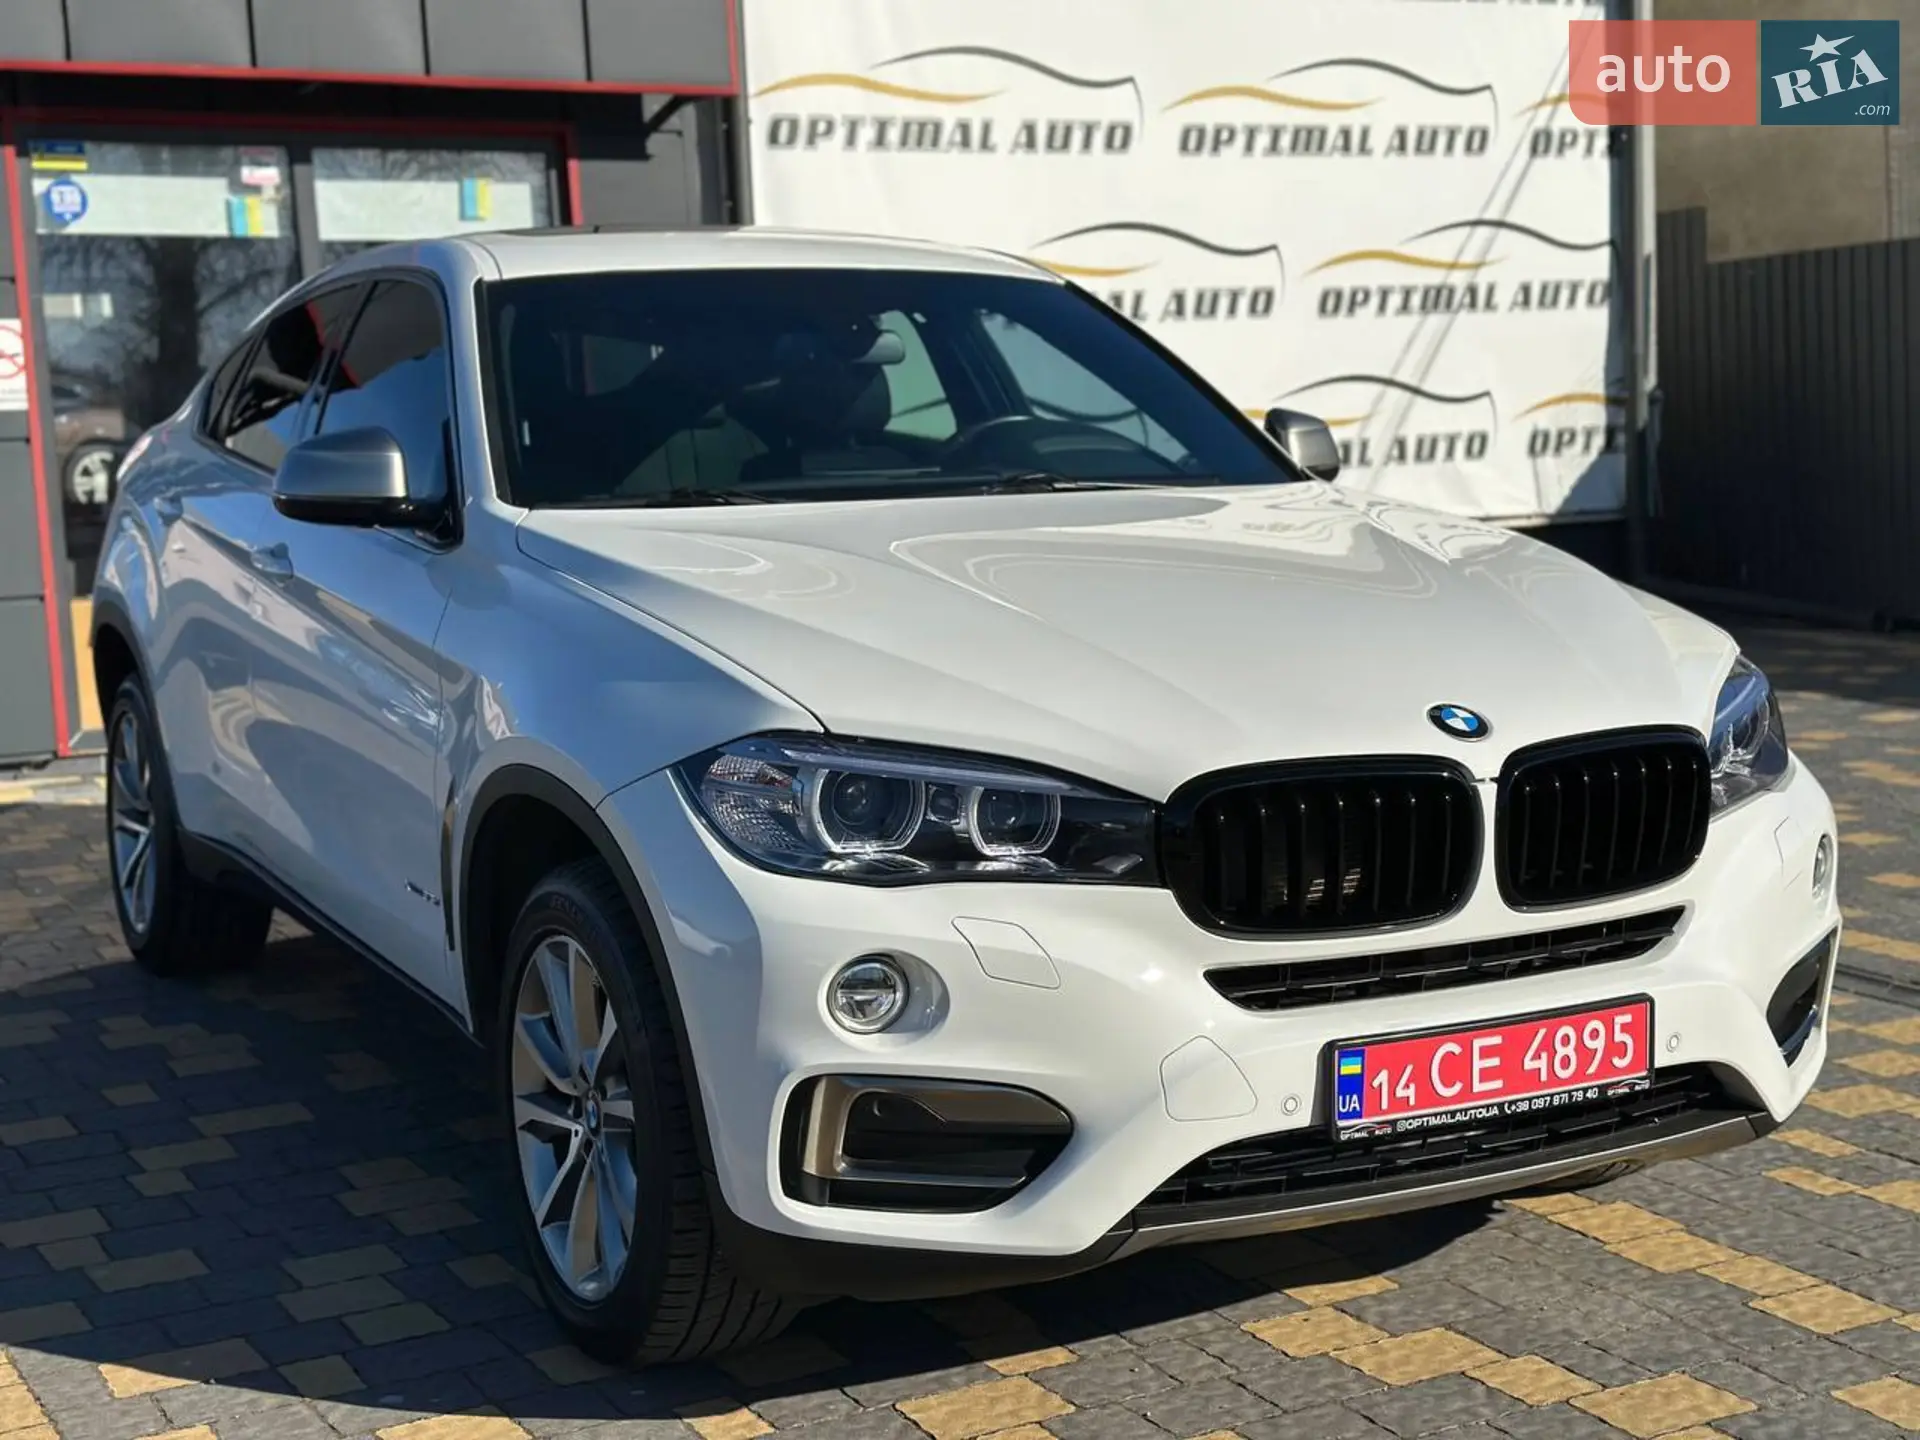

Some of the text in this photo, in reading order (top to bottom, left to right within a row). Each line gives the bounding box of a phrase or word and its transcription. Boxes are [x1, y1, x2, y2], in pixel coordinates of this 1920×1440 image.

[766, 113, 1135, 155] OPTIMAL AUTO
[1178, 123, 1491, 158] OPTIMAL AUTO
[1159, 287, 1276, 324] AUTO
[1317, 278, 1611, 318] OPTIMAL AUTO
[1383, 431, 1490, 466] AUTO
[1371, 1013, 1634, 1111] 14 CE 4895
[1338, 1093, 1361, 1113] UA
